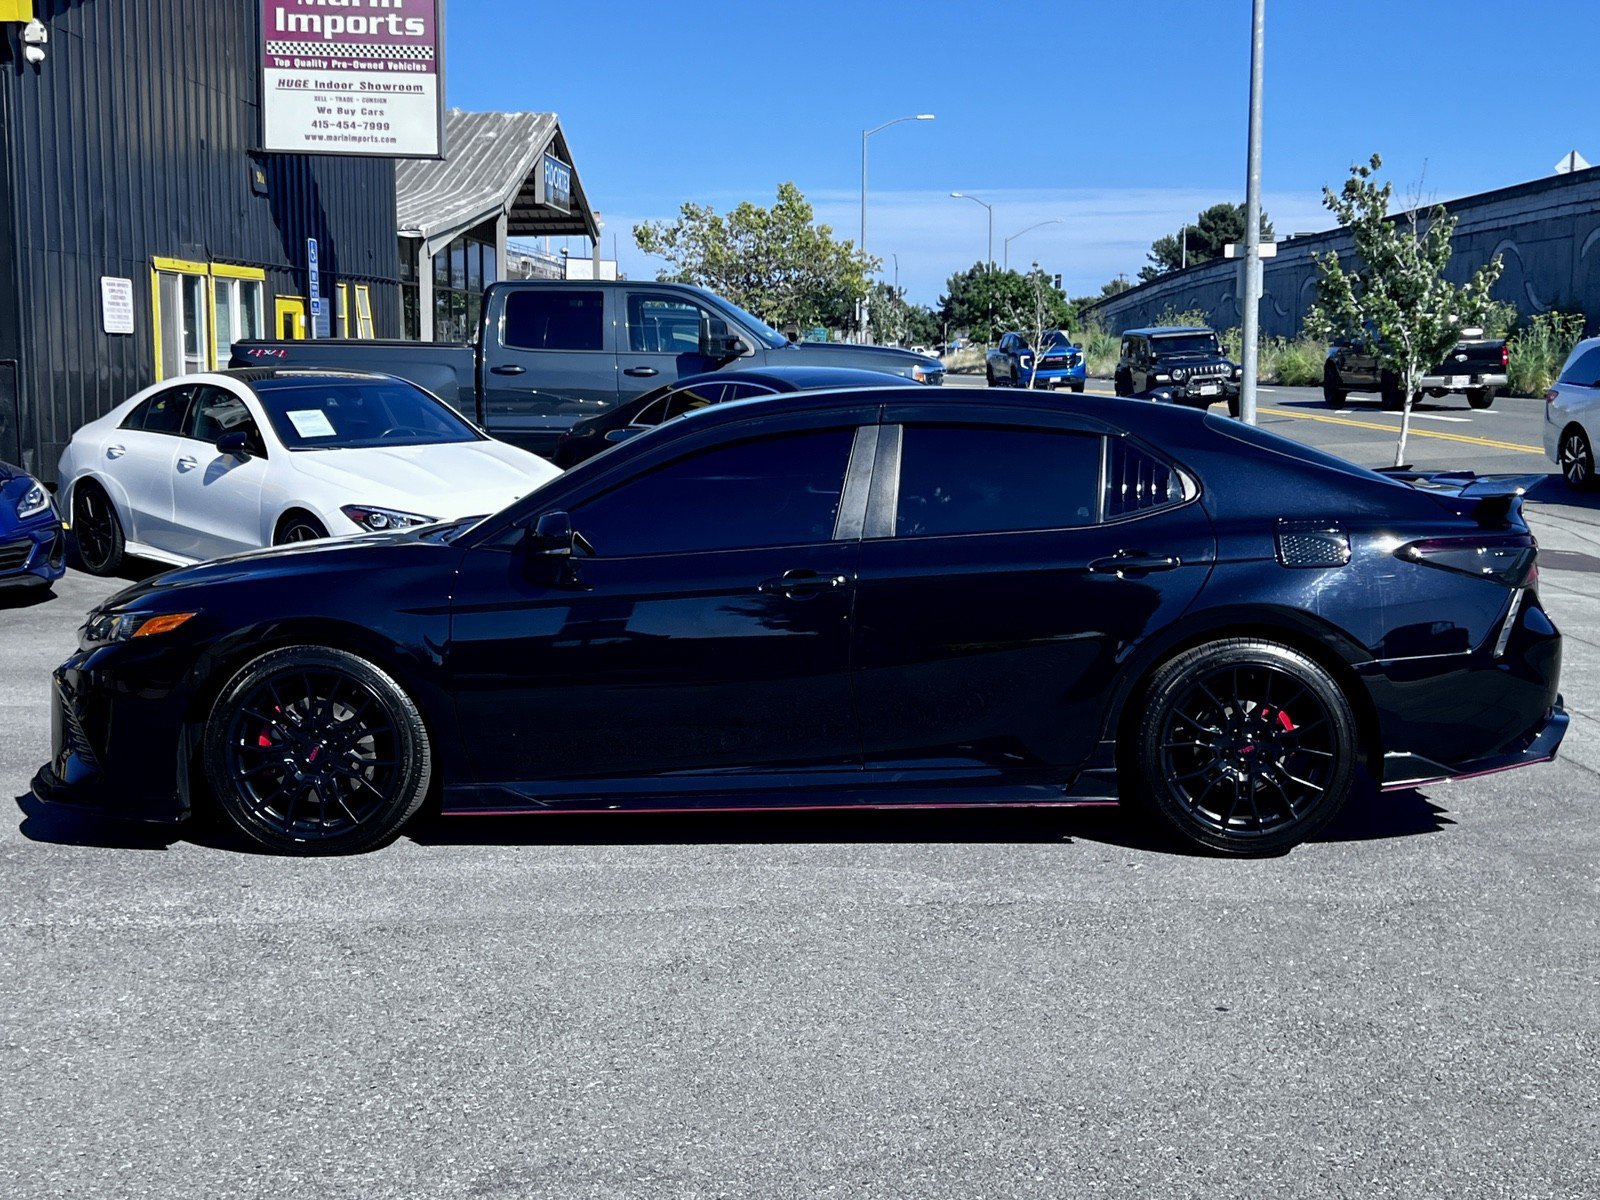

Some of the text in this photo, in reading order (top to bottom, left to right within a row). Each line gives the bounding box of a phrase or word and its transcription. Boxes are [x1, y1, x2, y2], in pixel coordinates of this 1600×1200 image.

[275, 7, 425, 40] Imports
[274, 57, 427, 72] Top Quality Pre-Owned Vehicles
[277, 78, 423, 92] HUGE Indoor Showroom
[317, 106, 385, 116] We Buy Cars
[311, 120, 390, 131] 415-454-7999
[304, 134, 397, 143] www.marinimports.com
